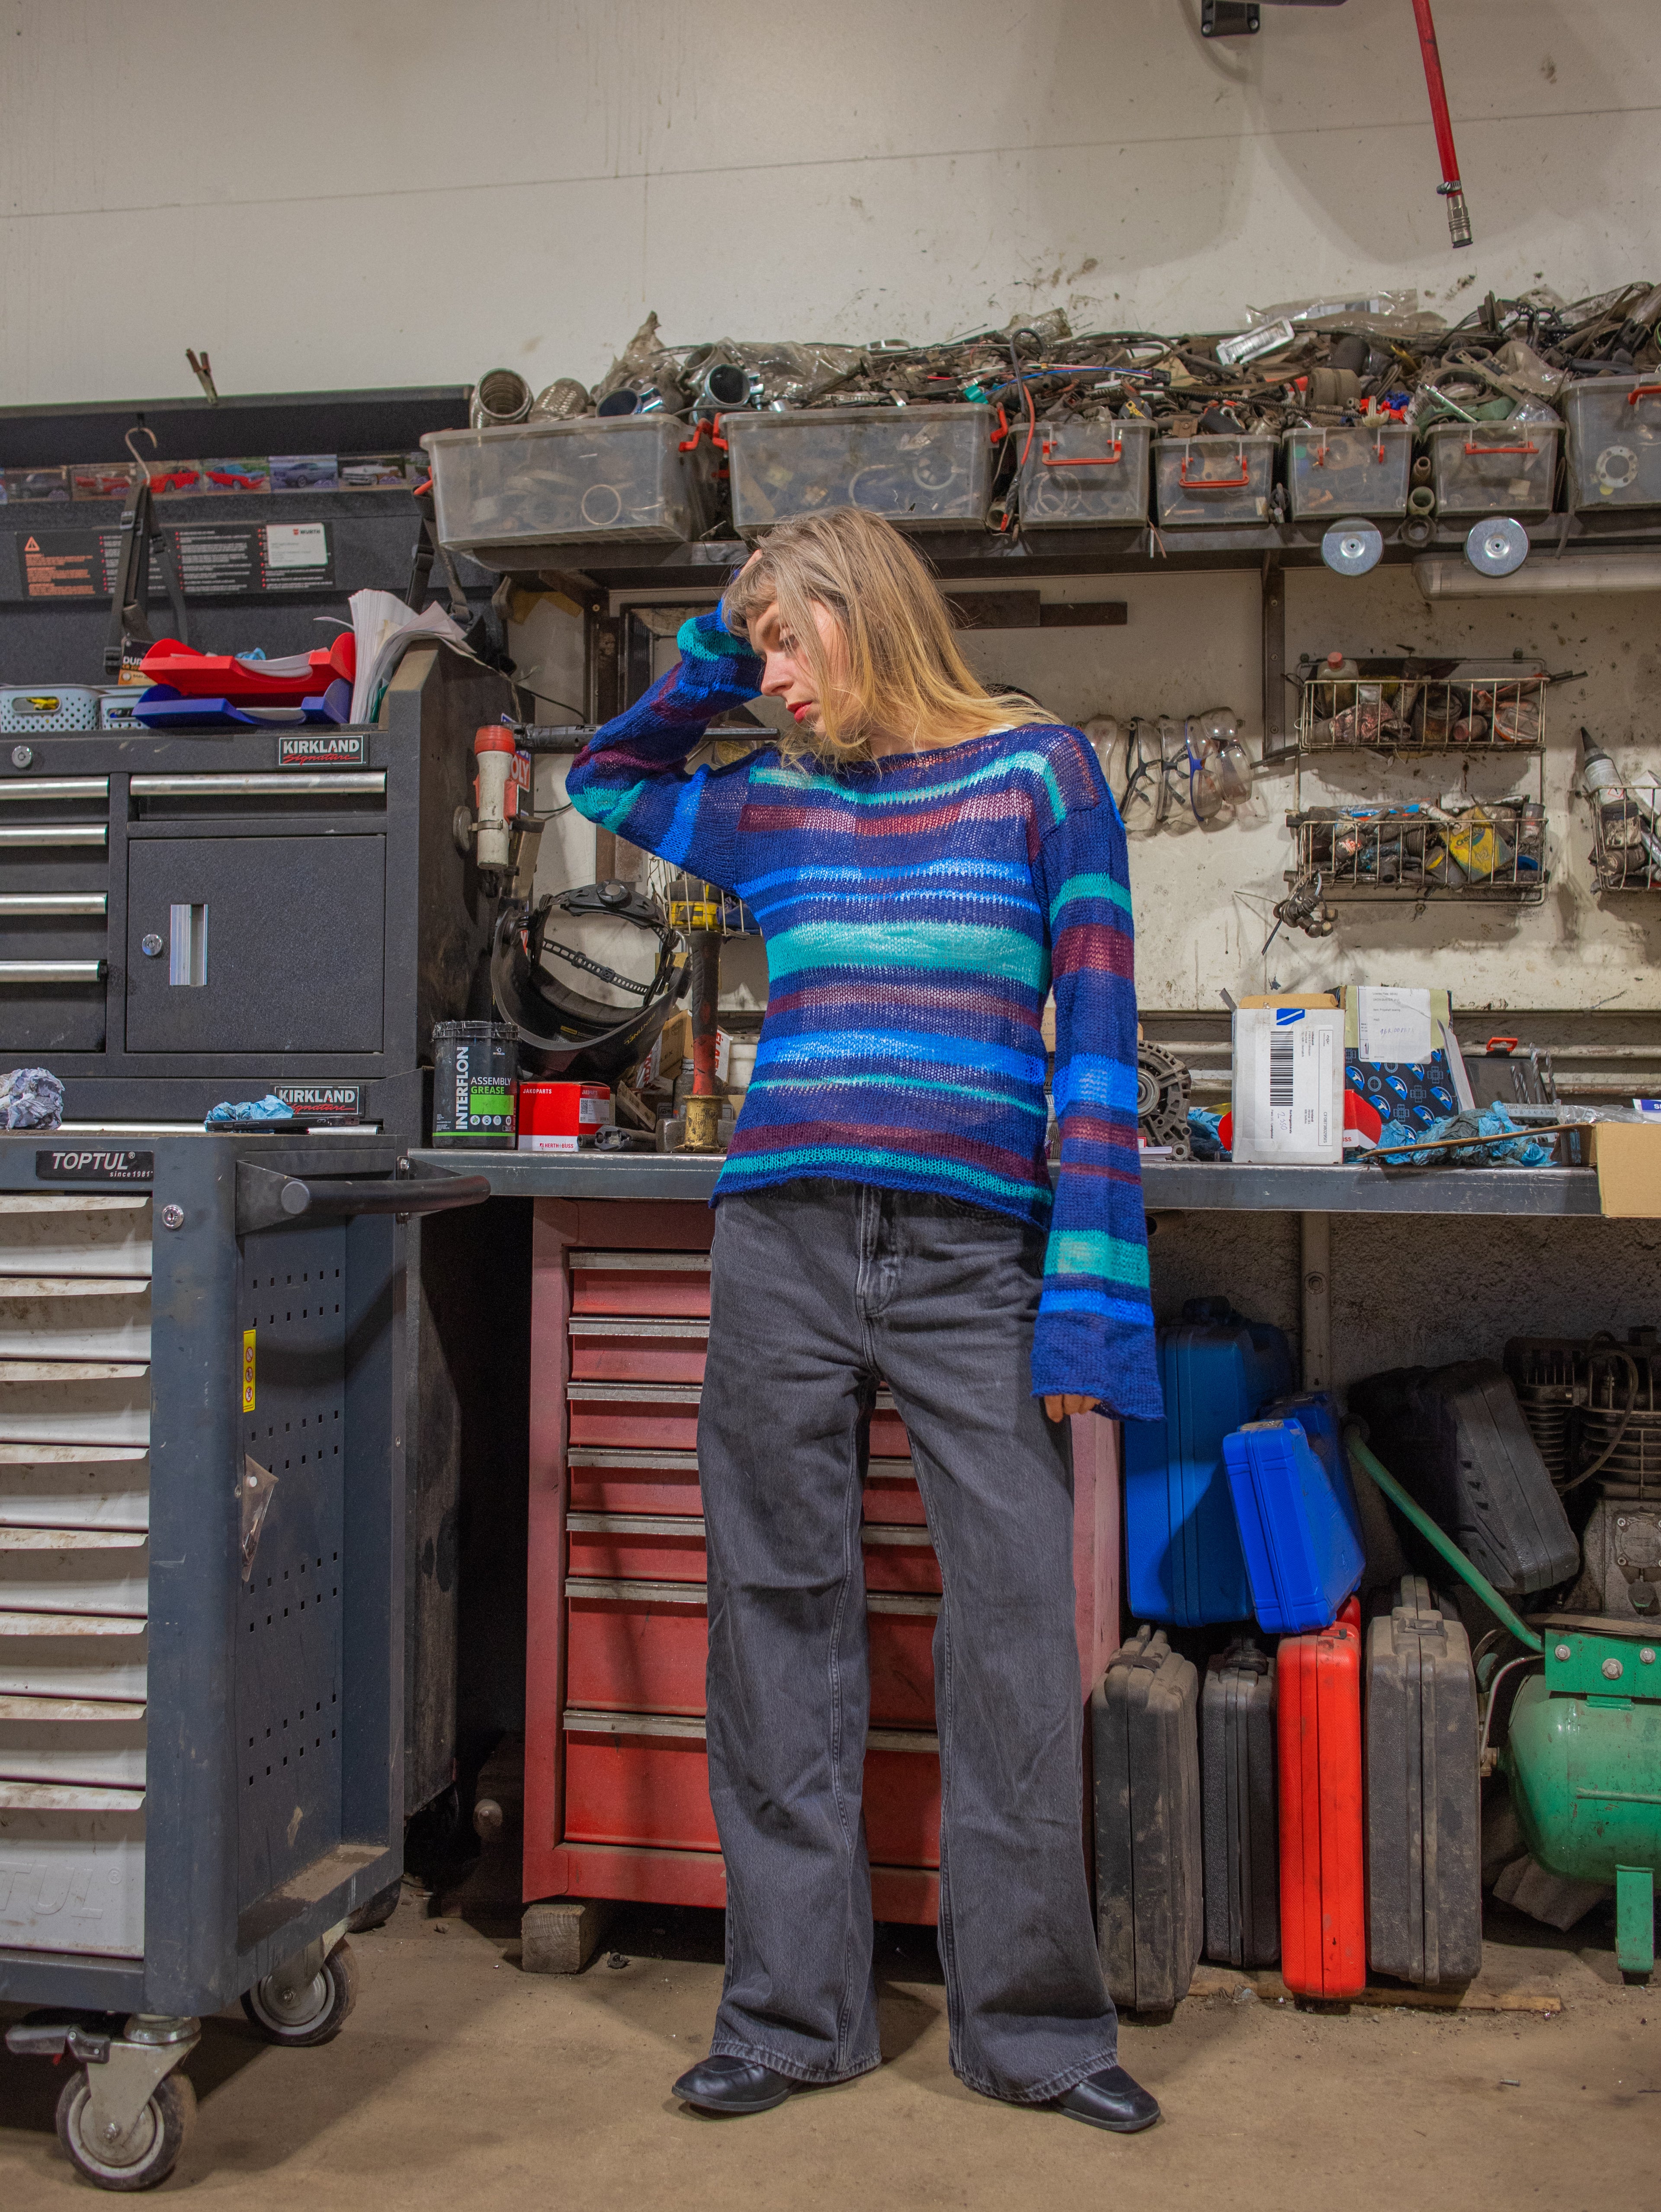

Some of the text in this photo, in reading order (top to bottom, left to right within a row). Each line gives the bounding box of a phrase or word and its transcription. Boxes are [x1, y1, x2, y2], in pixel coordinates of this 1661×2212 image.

[123, 656, 143, 665] DUR
[283, 739, 359, 754] KIRKLAND
[283, 753, 359, 765] Signature
[511, 756, 529, 786] OLY
[624, 1012, 656, 1044] SENTINEL
[471, 1077, 511, 1086] ASSEMBLY
[455, 1047, 469, 1129] INTERFLON
[471, 1086, 505, 1095] GREASE
[279, 1090, 355, 1103] KIRKLAND
[285, 1103, 355, 1114] ignature
